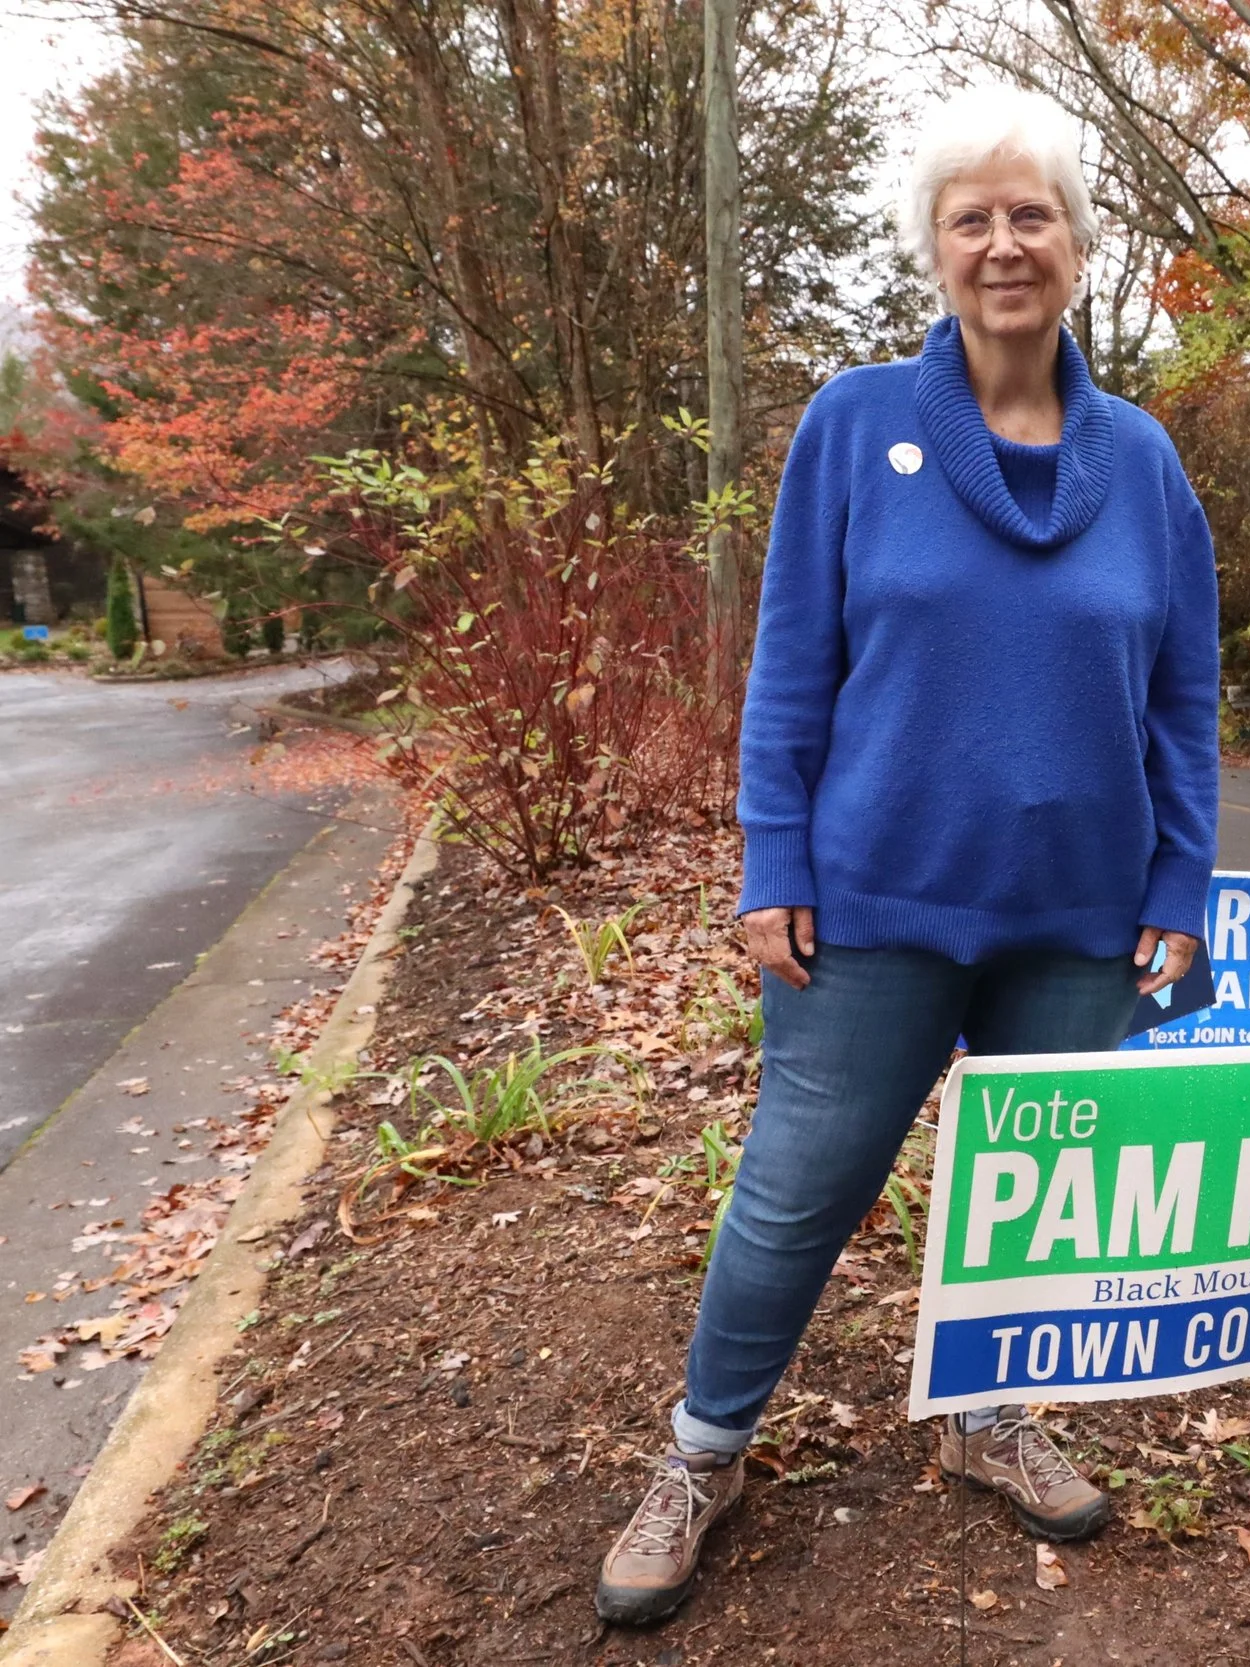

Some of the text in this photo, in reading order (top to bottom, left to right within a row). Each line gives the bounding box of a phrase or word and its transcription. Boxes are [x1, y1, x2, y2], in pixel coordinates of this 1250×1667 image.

[1147, 1027, 1187, 1044] Text
[1190, 1027, 1235, 1044] JOIN
[982, 1087, 1098, 1143] Vote
[963, 1141, 1206, 1268] PAM
[1092, 1274, 1181, 1303] Black
[992, 1318, 1159, 1383] TOWN
